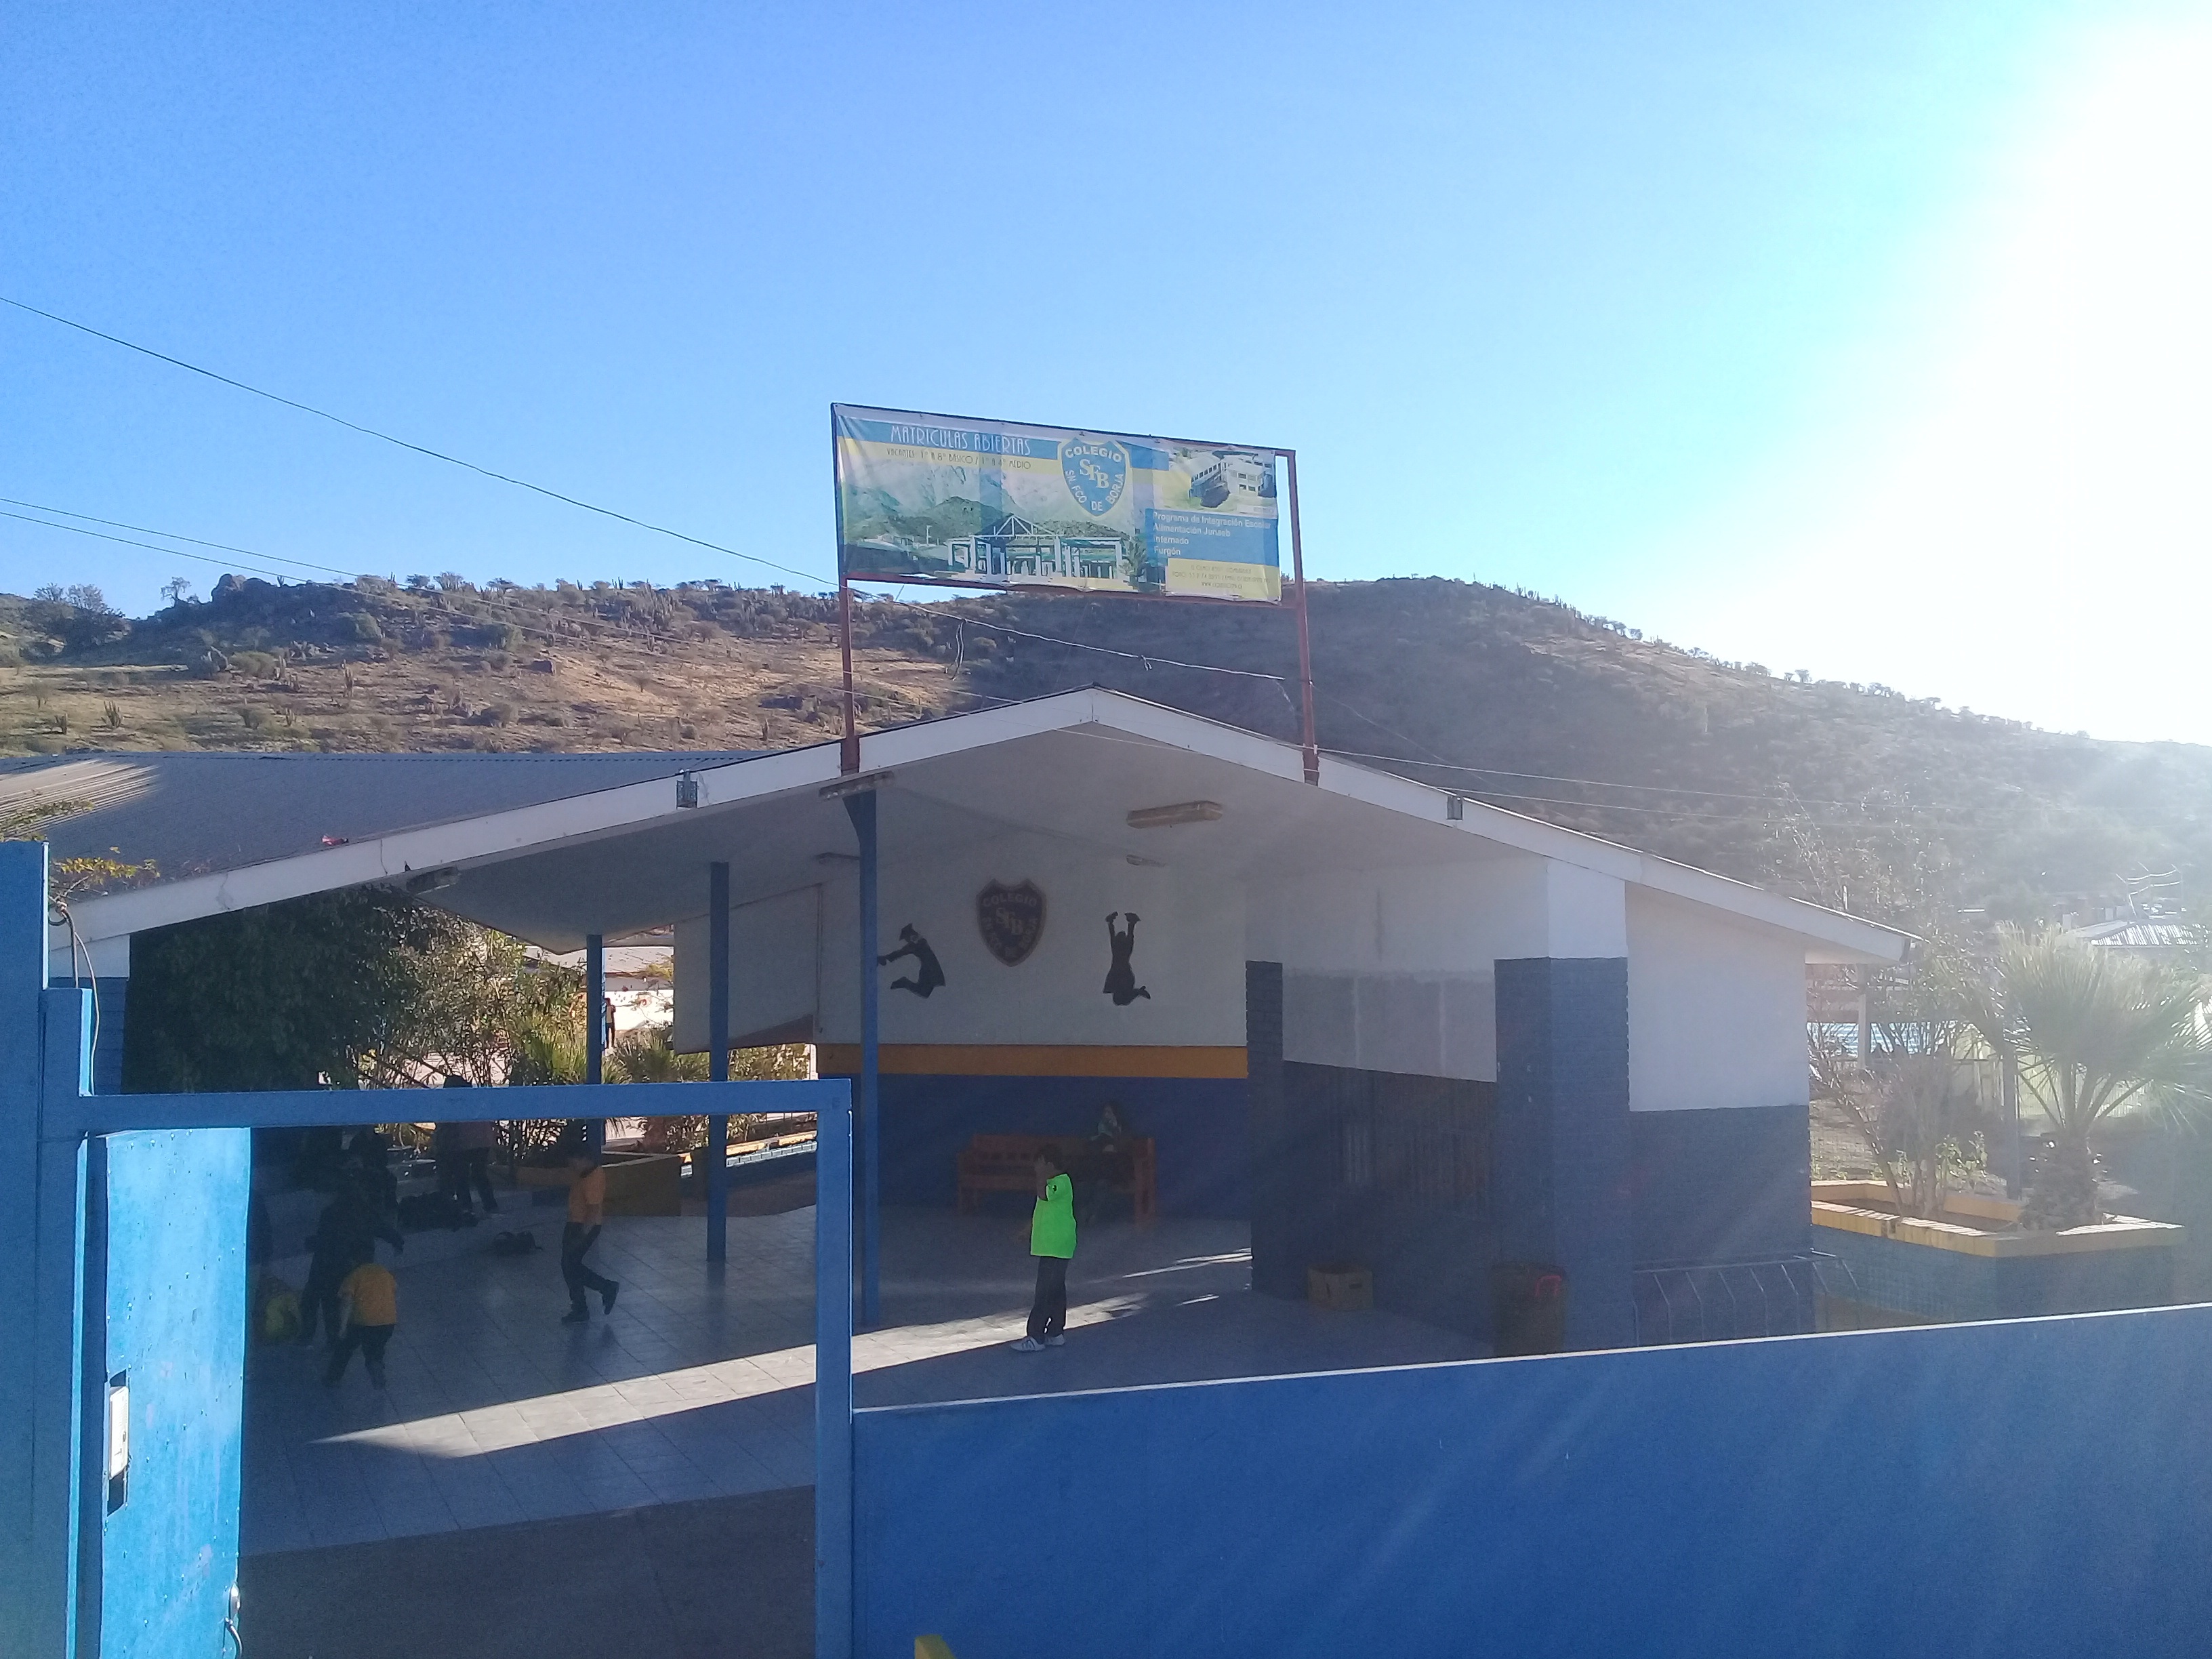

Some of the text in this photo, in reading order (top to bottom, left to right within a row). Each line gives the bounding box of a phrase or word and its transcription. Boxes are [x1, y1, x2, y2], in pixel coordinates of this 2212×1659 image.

[890, 426, 1031, 455] MATRICULAS ABIERTAS
[1065, 445, 1122, 463] COLEGIO
[1071, 485, 1087, 504] FCO
[1091, 501, 1103, 511] DE
[1105, 474, 1124, 505] BORJA
[1191, 515, 1200, 523] de
